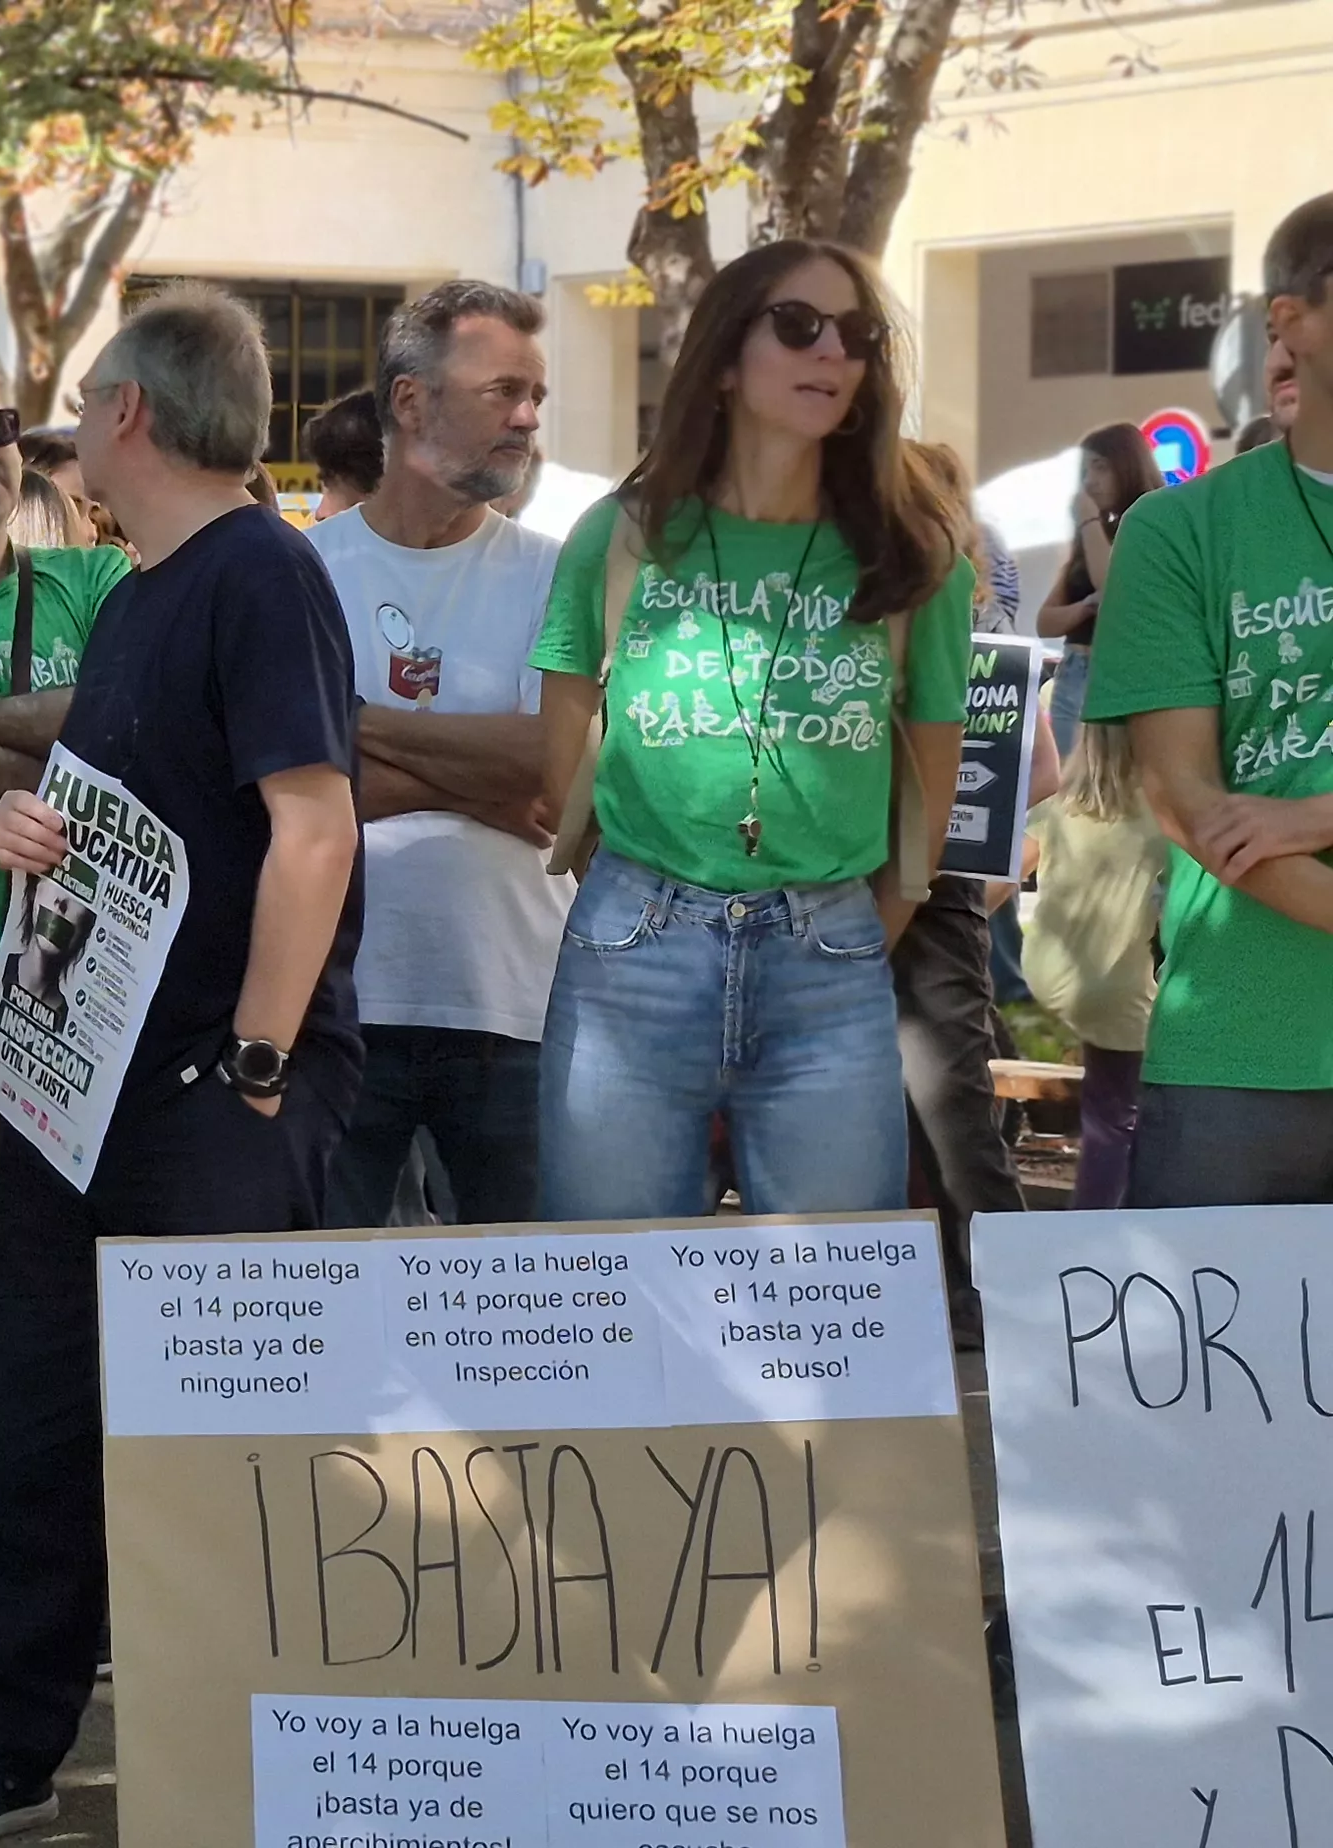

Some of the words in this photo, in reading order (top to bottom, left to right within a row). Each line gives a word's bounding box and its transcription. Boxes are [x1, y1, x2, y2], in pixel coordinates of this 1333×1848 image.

[642, 576, 773, 622] ESCUELA
[665, 650, 722, 680] DE
[744, 652, 882, 690] TOD@S
[1269, 672, 1322, 711] DE
[637, 705, 757, 738] PARA
[44, 763, 176, 875] HUELGA
[66, 820, 171, 909] UCATIVA
[103, 880, 154, 928] HUESCA
[106, 905, 150, 943] PROVINCIA
[9, 984, 32, 1014] POR
[32, 1001, 55, 1030] UNA
[0, 1005, 90, 1091] INSPECCIÓN
[26, 1059, 36, 1079] Y
[35, 1069, 71, 1110] JUSTA
[399, 1255, 431, 1277] Yo
[439, 1258, 482, 1279] voy
[491, 1258, 506, 1274] a
[515, 1252, 536, 1273] la
[544, 1252, 629, 1276] huelga
[670, 1244, 704, 1268] Yo
[714, 1248, 760, 1271] voy
[769, 1248, 785, 1264] a
[794, 1241, 817, 1263] la
[826, 1239, 917, 1263] huelga
[121, 1258, 153, 1281] Yo
[163, 1263, 207, 1286] voy
[217, 1264, 231, 1280] a
[241, 1258, 263, 1280] la
[272, 1258, 360, 1284] huelga
[160, 1297, 181, 1318] el
[194, 1297, 222, 1317] 14
[232, 1300, 323, 1323] porque
[407, 1291, 427, 1312] el
[439, 1290, 467, 1311] 14
[476, 1292, 563, 1315] porque
[572, 1290, 627, 1308] creo
[714, 1282, 736, 1305] el
[747, 1281, 778, 1304] 14
[788, 1282, 882, 1307] porque
[163, 1335, 243, 1362] ¡basta
[253, 1340, 282, 1361] ya
[292, 1333, 325, 1355] de
[405, 1330, 436, 1347] en
[445, 1328, 493, 1347] otro
[501, 1323, 594, 1346] modelo
[602, 1322, 633, 1344] de
[720, 1319, 802, 1347] ¡basta
[812, 1323, 842, 1345] ya
[851, 1316, 885, 1339] de
[1058, 1266, 1272, 1424] POR
[455, 1358, 590, 1387] Inspección
[761, 1356, 851, 1380] abuso!
[180, 1372, 309, 1399] ninguneo!
[246, 1443, 619, 1674] ¡BASTA
[644, 1439, 822, 1677] YA!
[1147, 1604, 1244, 1687] EL
[271, 1709, 306, 1733] Yo
[315, 1716, 362, 1740] voy
[372, 1718, 387, 1735] a
[397, 1713, 420, 1736] la
[431, 1714, 521, 1745] huelga
[562, 1717, 597, 1741] Yo
[607, 1723, 654, 1747] voy
[664, 1726, 679, 1743] a
[689, 1721, 712, 1744] la
[723, 1722, 816, 1750] huelga
[312, 1751, 335, 1774] el
[347, 1751, 378, 1775] 14
[388, 1757, 483, 1782] porque
[605, 1758, 627, 1781] el
[640, 1759, 670, 1782] 14
[682, 1764, 778, 1788] porque
[316, 1791, 398, 1818] ¡basta
[408, 1798, 440, 1821] ya
[449, 1795, 483, 1818] de
[569, 1797, 656, 1824] quiero
[665, 1803, 716, 1827] que
[726, 1805, 758, 1824] se
[768, 1806, 818, 1826] nos
